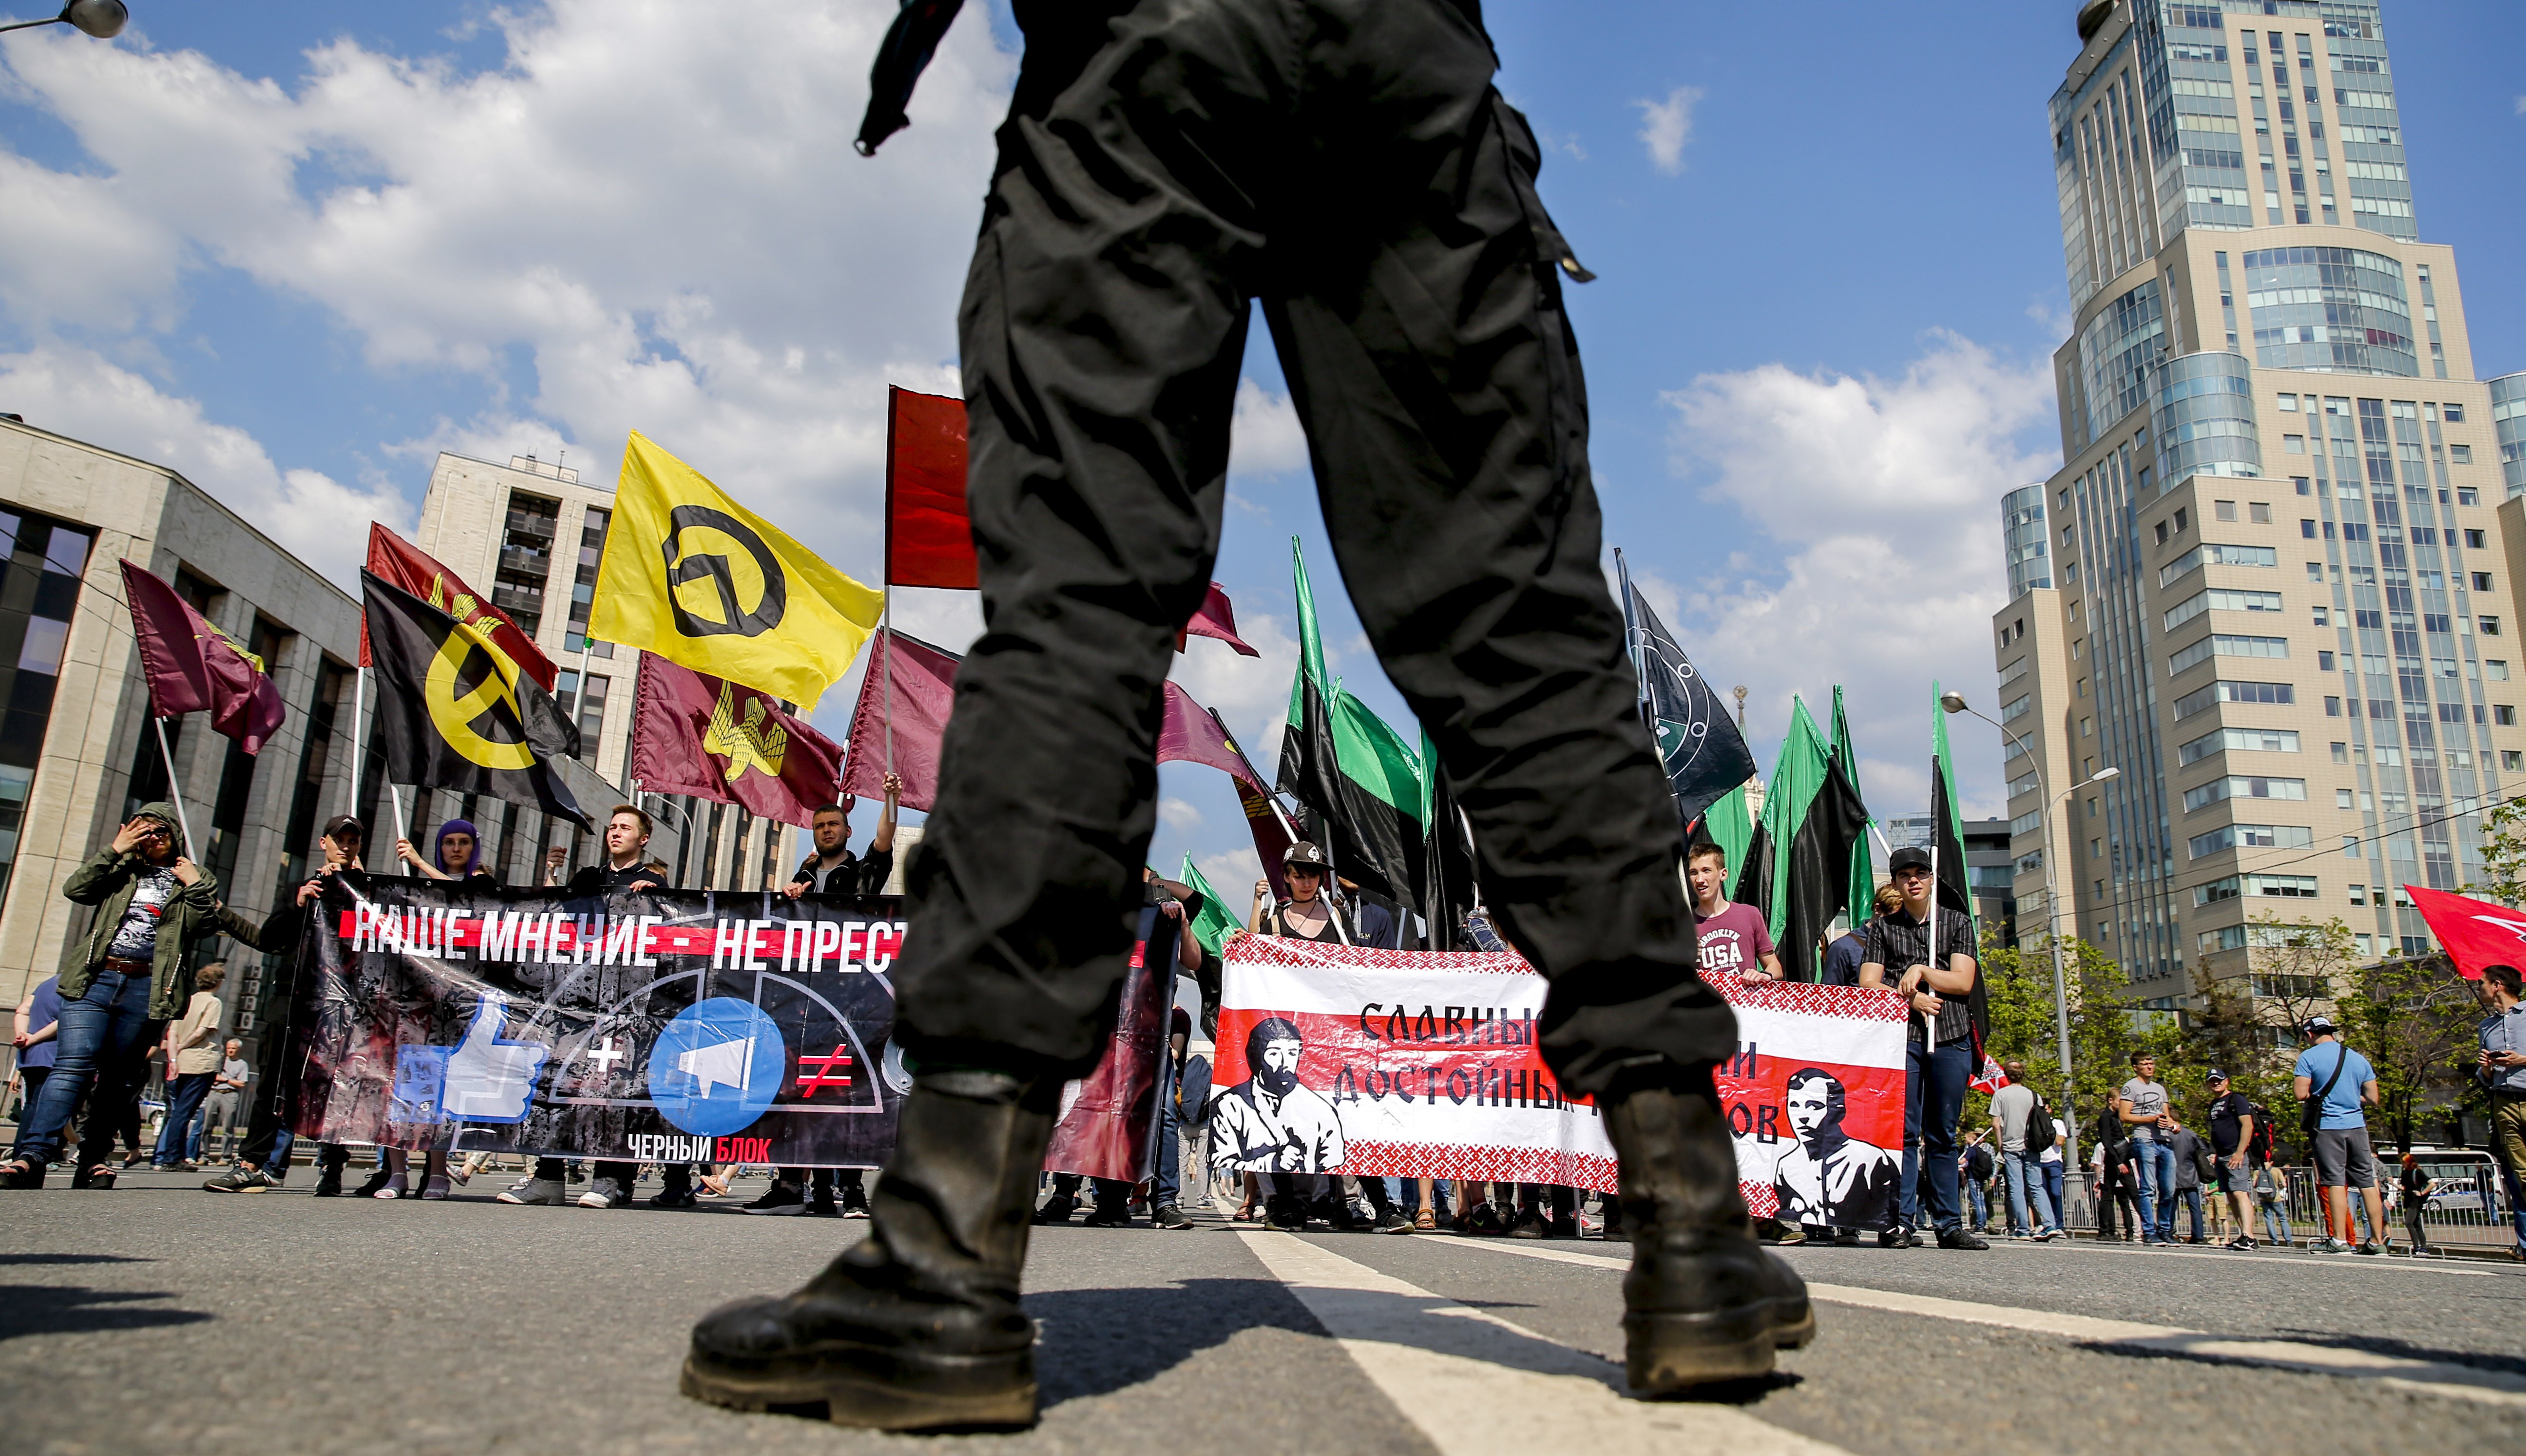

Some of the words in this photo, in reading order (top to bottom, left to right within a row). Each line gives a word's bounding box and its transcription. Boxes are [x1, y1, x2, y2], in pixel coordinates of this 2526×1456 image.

[352, 901, 472, 960] НАШЕ
[479, 910, 663, 967] МНЕНИЕ
[713, 919, 772, 971] НЕ
[781, 920, 908, 974] ПРЕС
[1700, 929, 1741, 948] BROOKLYN
[1701, 942, 1743, 969] USA
[628, 1131, 711, 1161] ЧЕРНЫЙ
[716, 1137, 772, 1163] БЛОК
